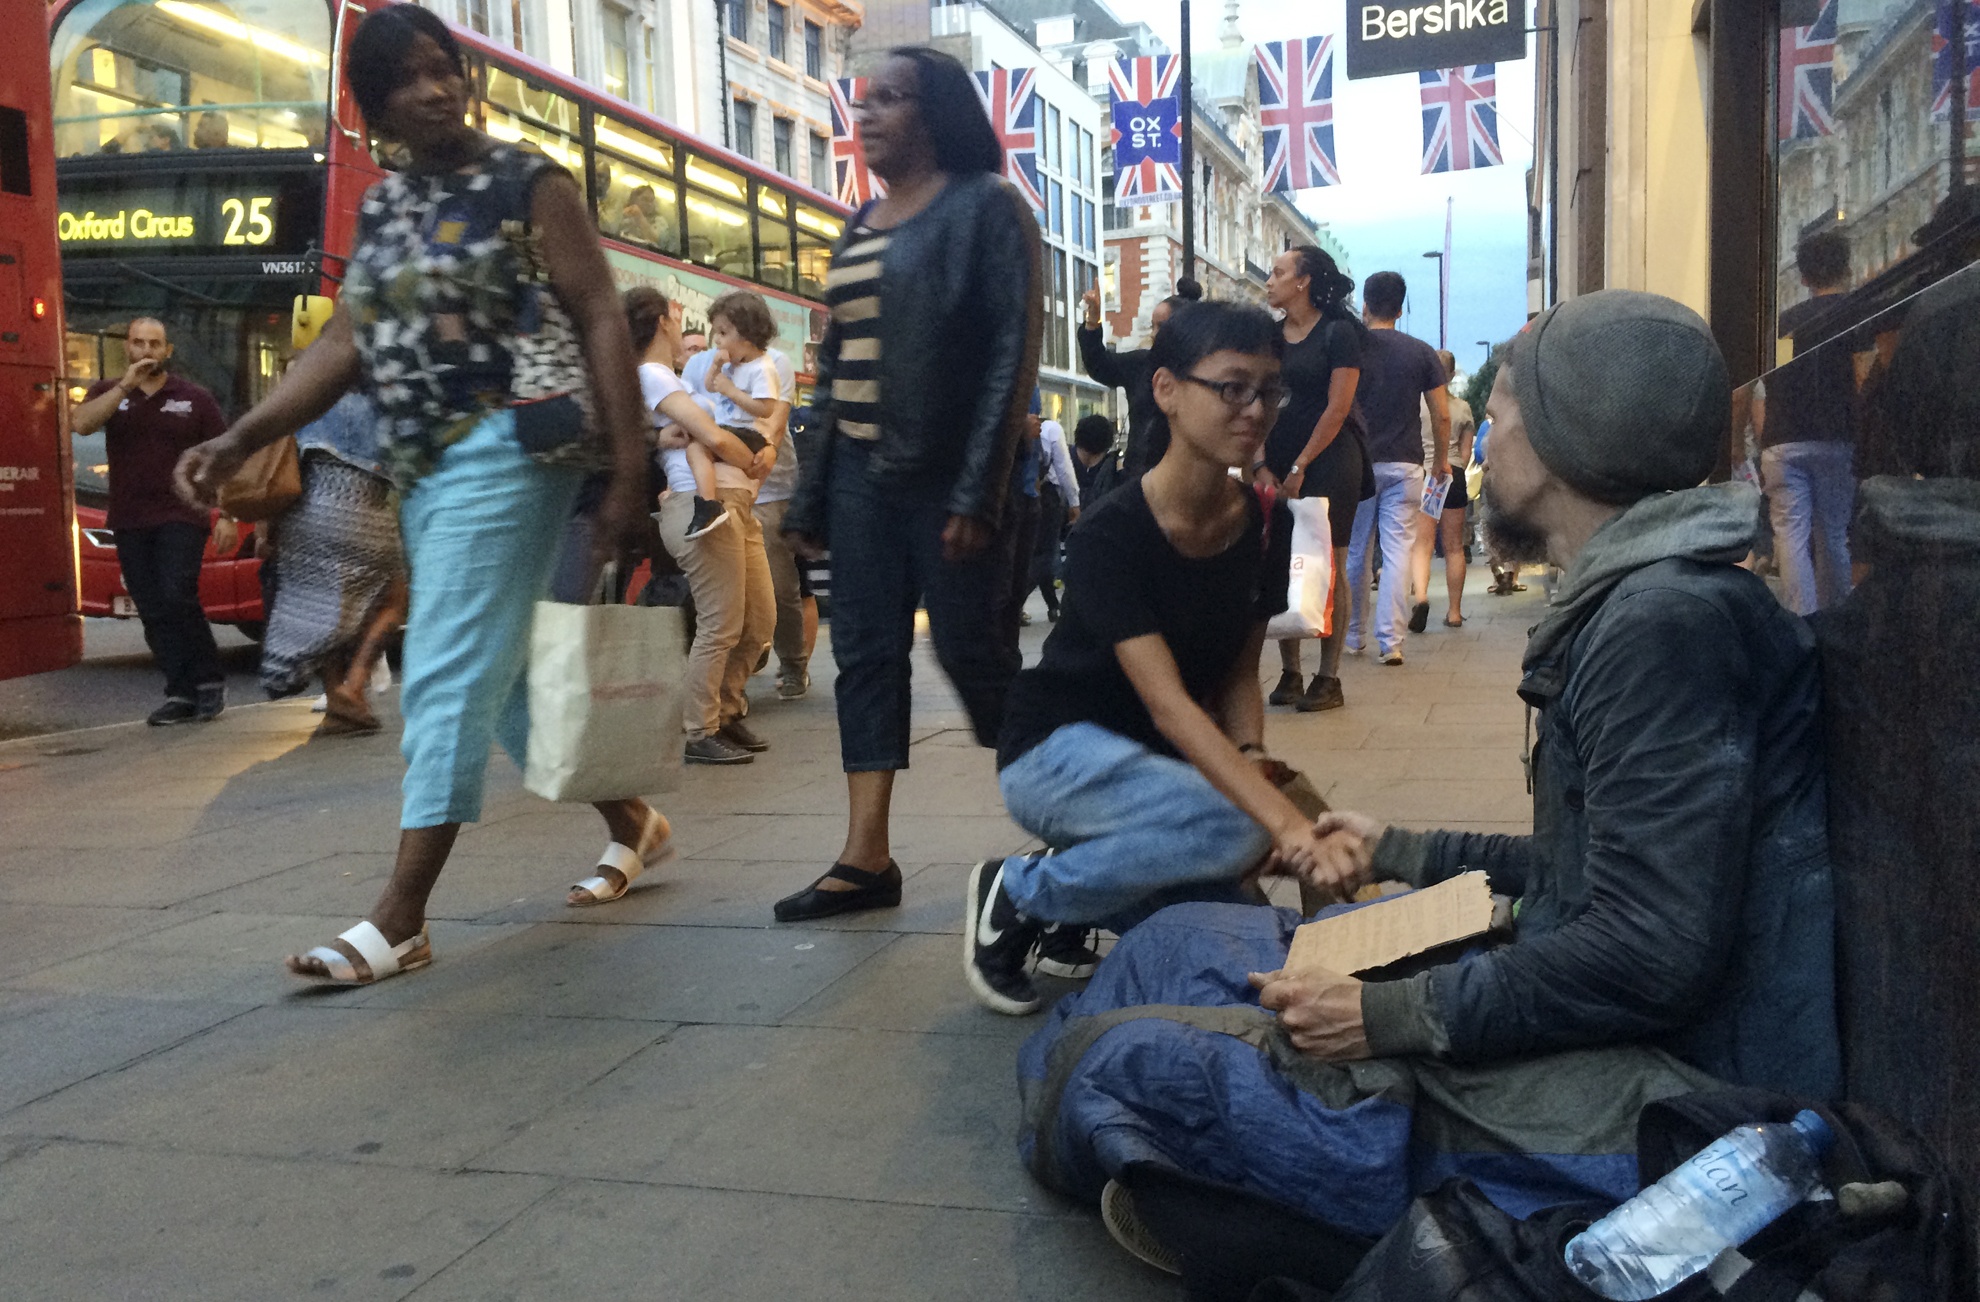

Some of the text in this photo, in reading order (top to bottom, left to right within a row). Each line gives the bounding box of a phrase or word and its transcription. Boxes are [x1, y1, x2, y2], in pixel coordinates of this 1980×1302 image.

[1362, 0, 1508, 41] Bershka
[1129, 116, 1161, 132] OX
[1131, 132, 1162, 148] ST.
[58, 209, 194, 241] Oxford Circus
[222, 197, 272, 245] 25
